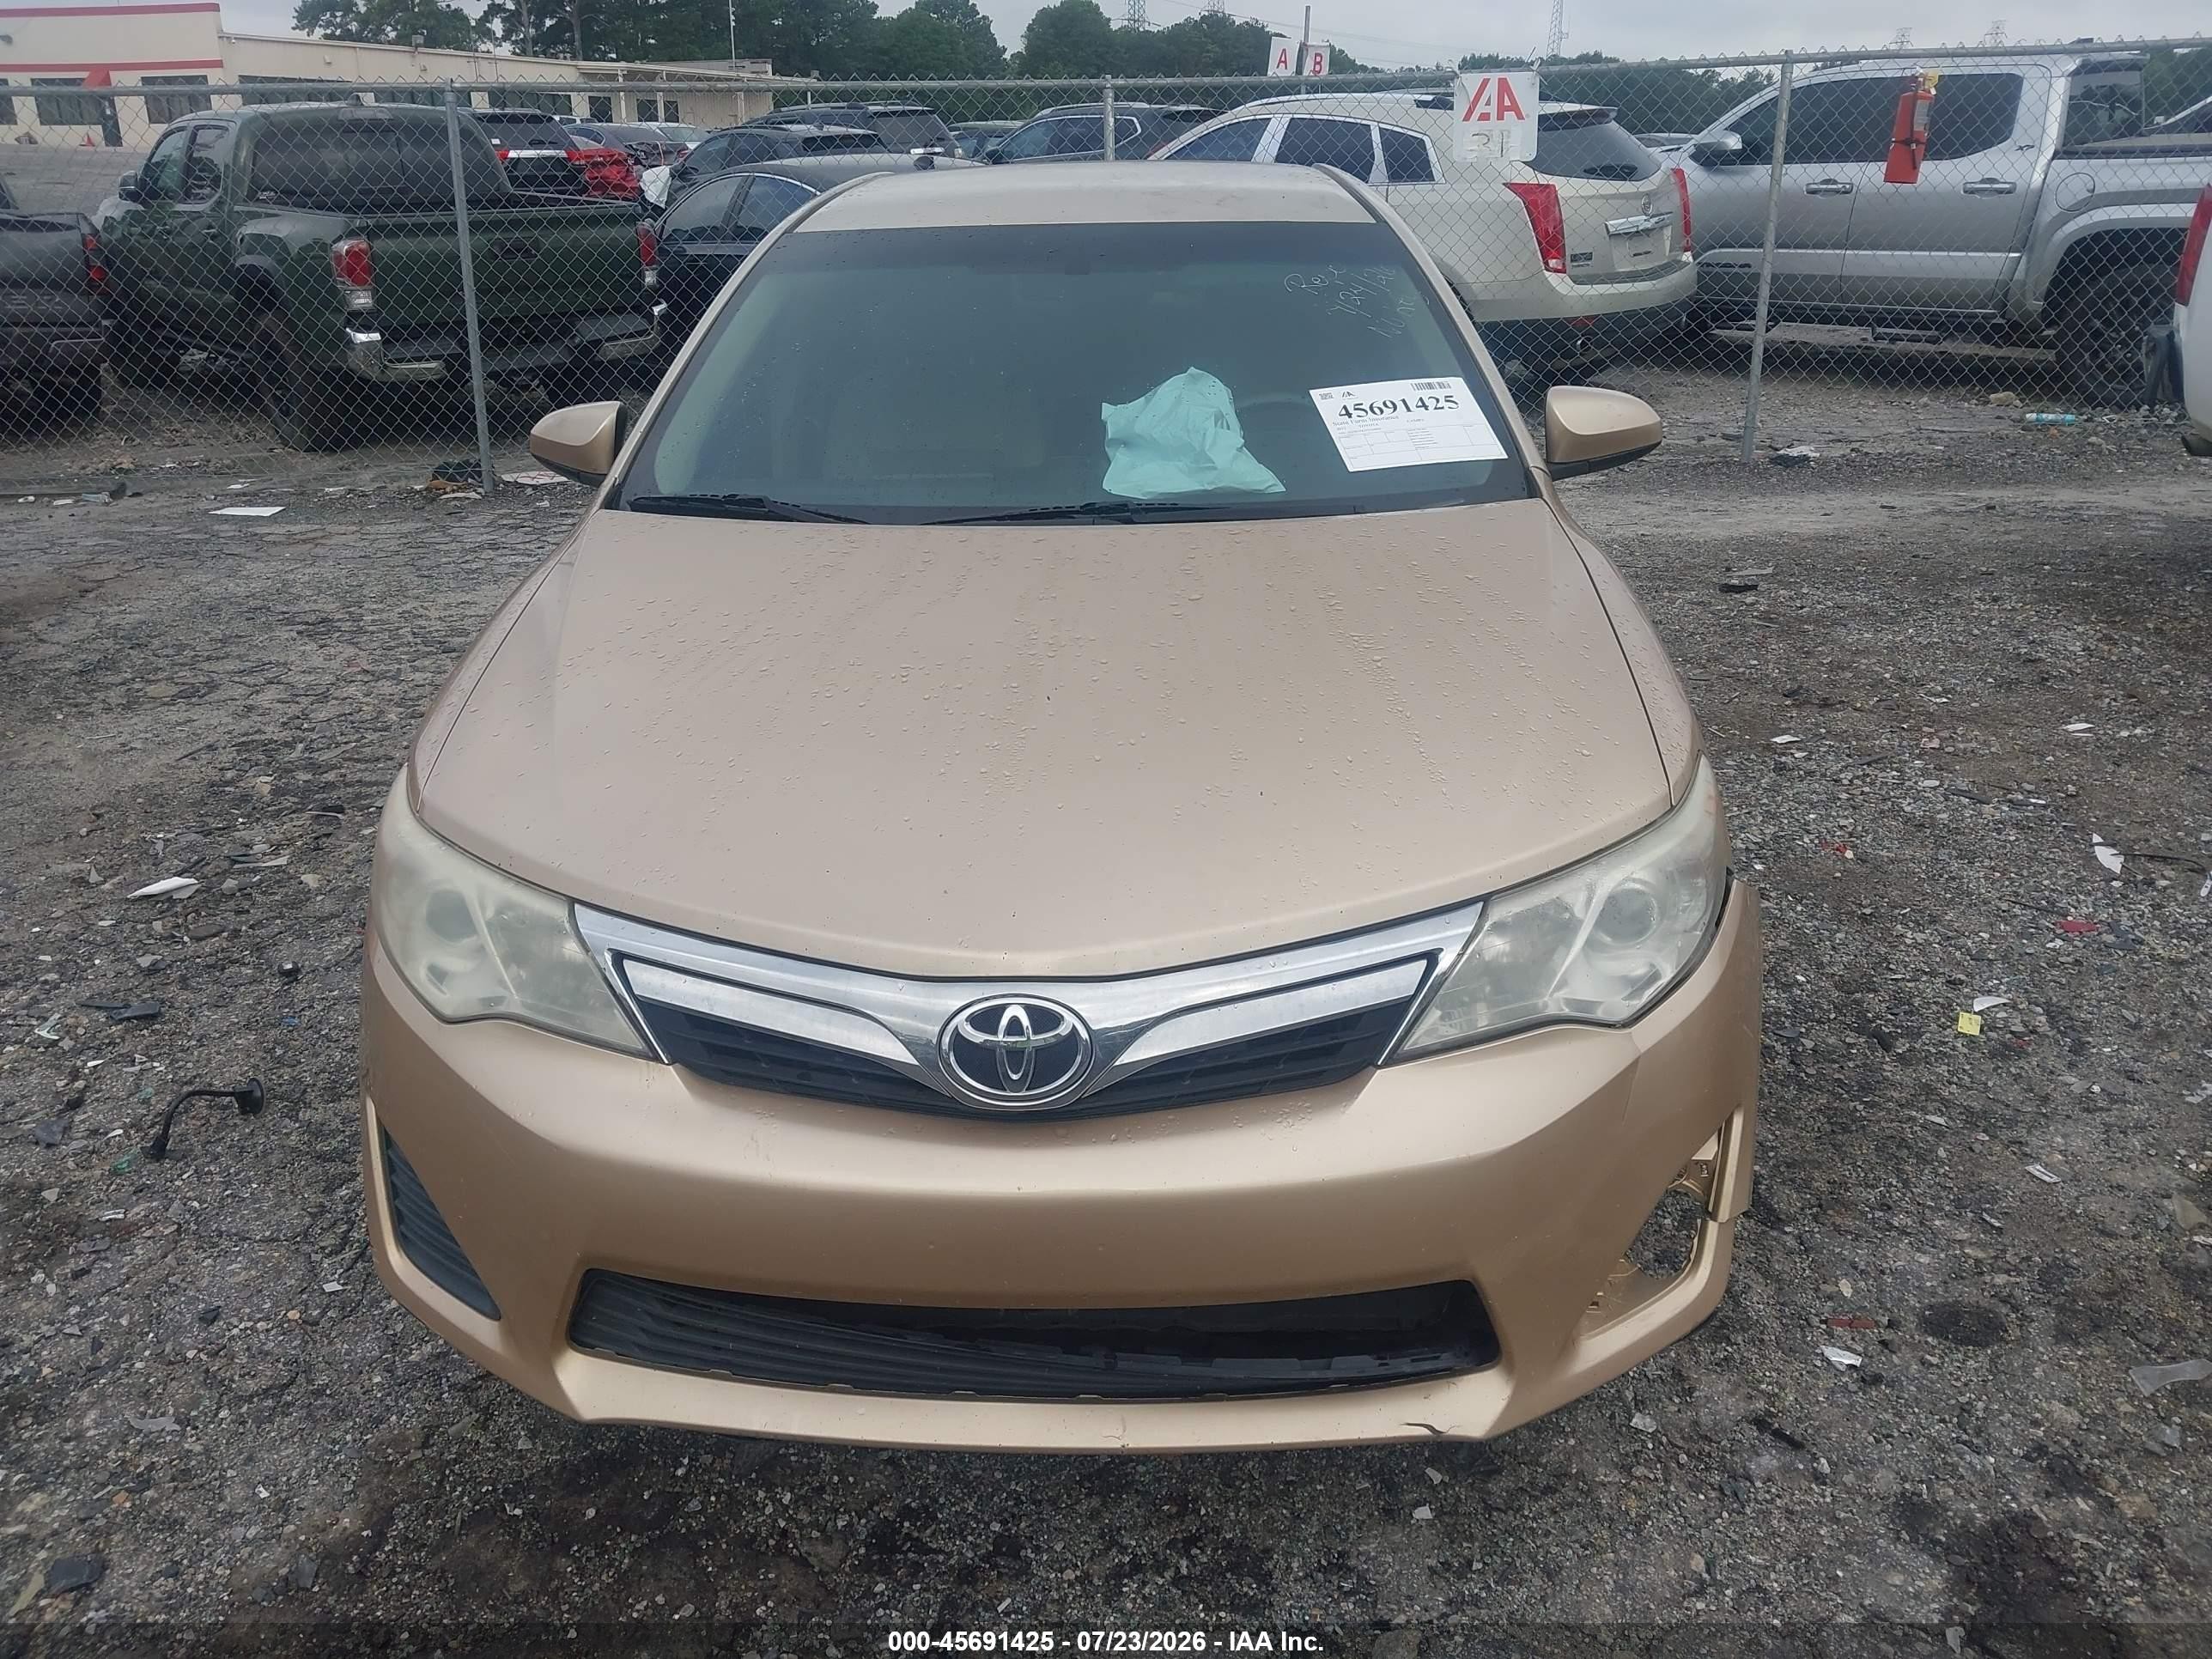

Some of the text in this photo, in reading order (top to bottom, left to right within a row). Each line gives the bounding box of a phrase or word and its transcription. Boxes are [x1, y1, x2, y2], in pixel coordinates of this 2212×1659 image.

[1276, 48, 1288, 70] A
[1313, 52, 1323, 75] B
[1338, 395, 1460, 419] 45691425
